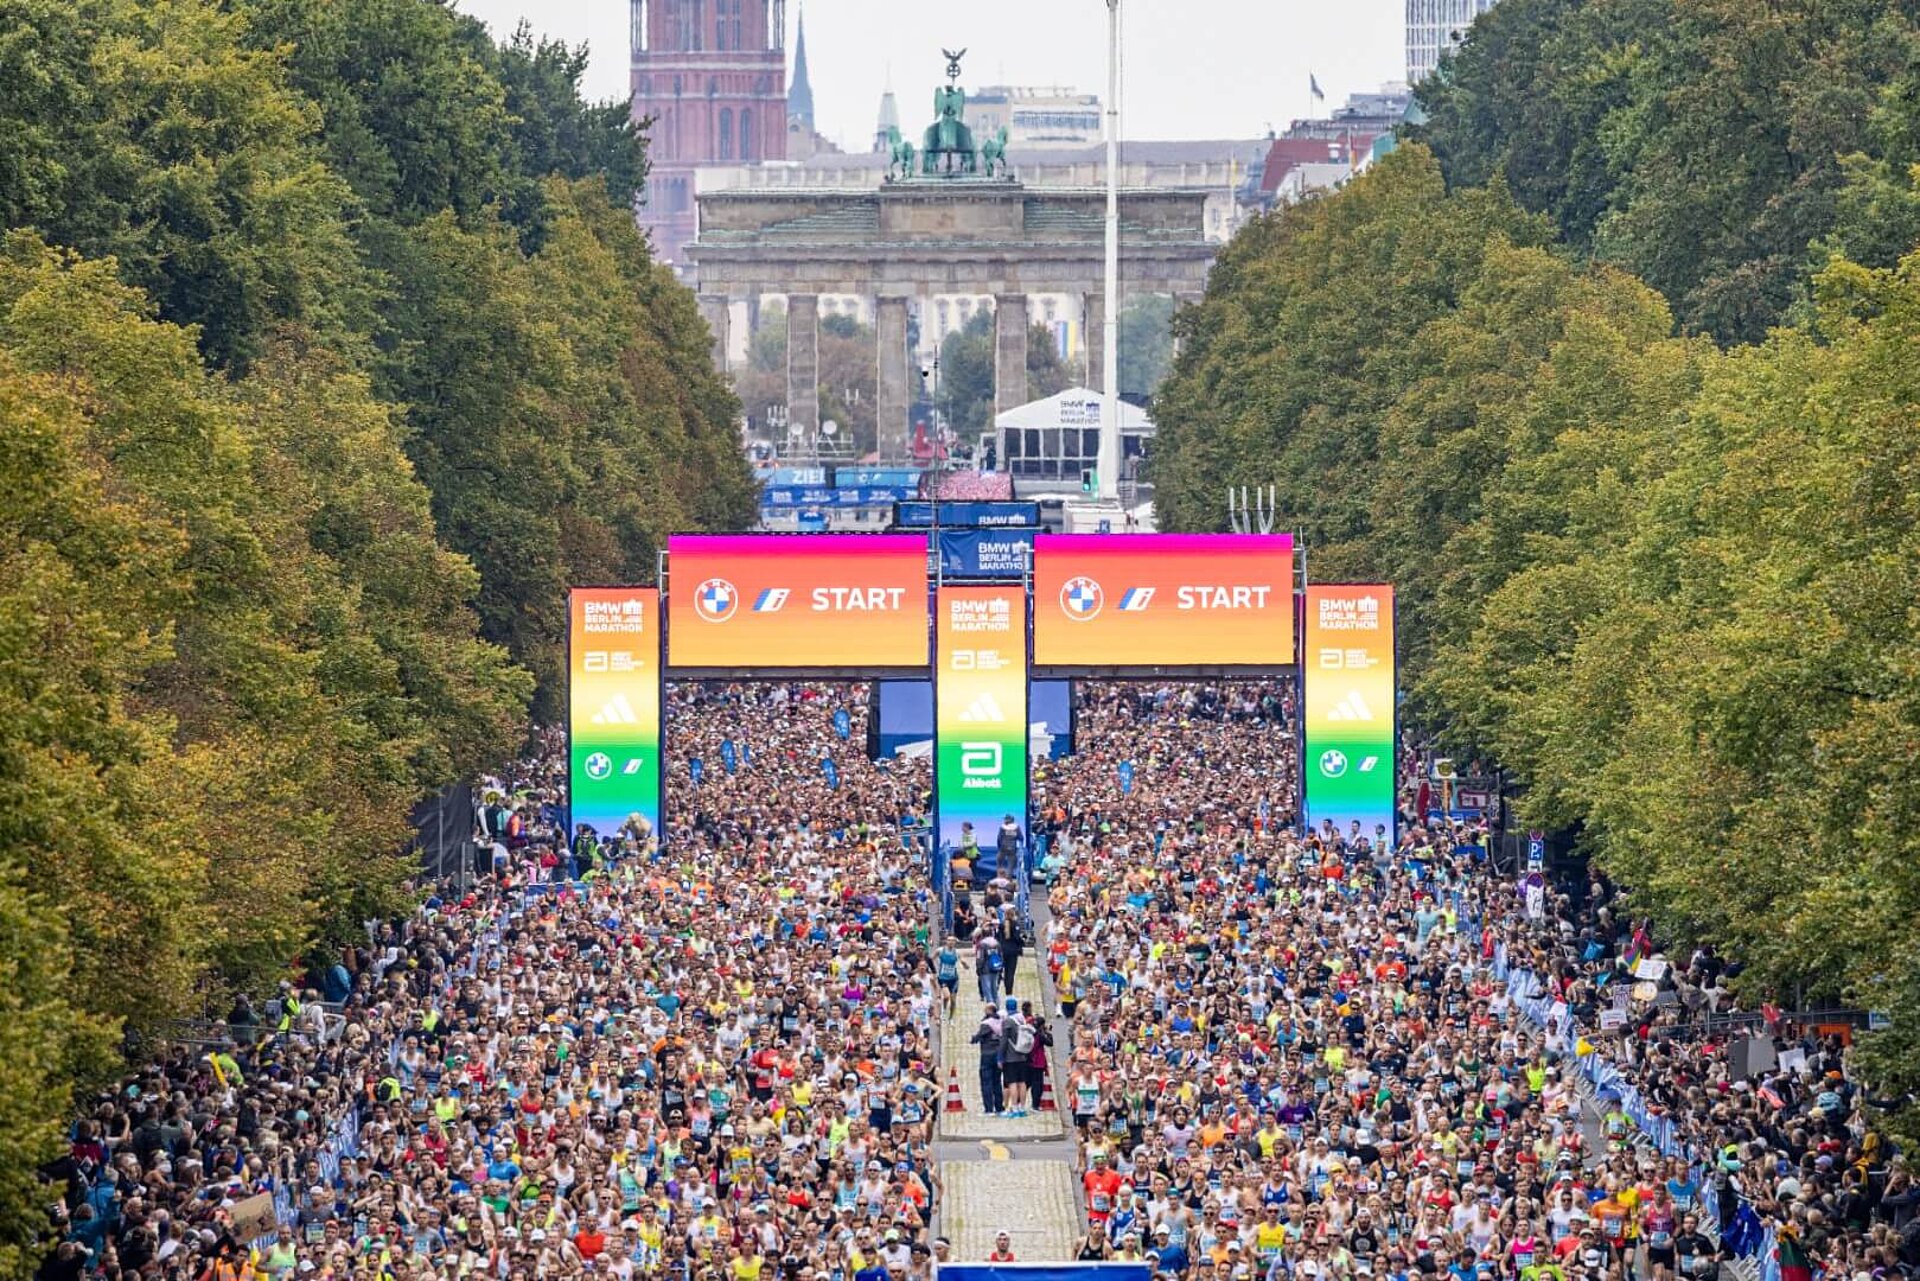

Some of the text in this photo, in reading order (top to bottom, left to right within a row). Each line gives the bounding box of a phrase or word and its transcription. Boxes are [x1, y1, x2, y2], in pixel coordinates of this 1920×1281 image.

[978, 515, 1007, 525] BMW
[978, 542, 1009, 553] BMW
[811, 588, 905, 611] START
[1177, 586, 1271, 610] START
[584, 602, 621, 614] BMW
[951, 600, 988, 612] BMW
[1320, 599, 1357, 611] BMW
[584, 623, 642, 633] MARATHON
[951, 621, 1009, 631] MARATHON
[1320, 620, 1378, 630] MARATHON
